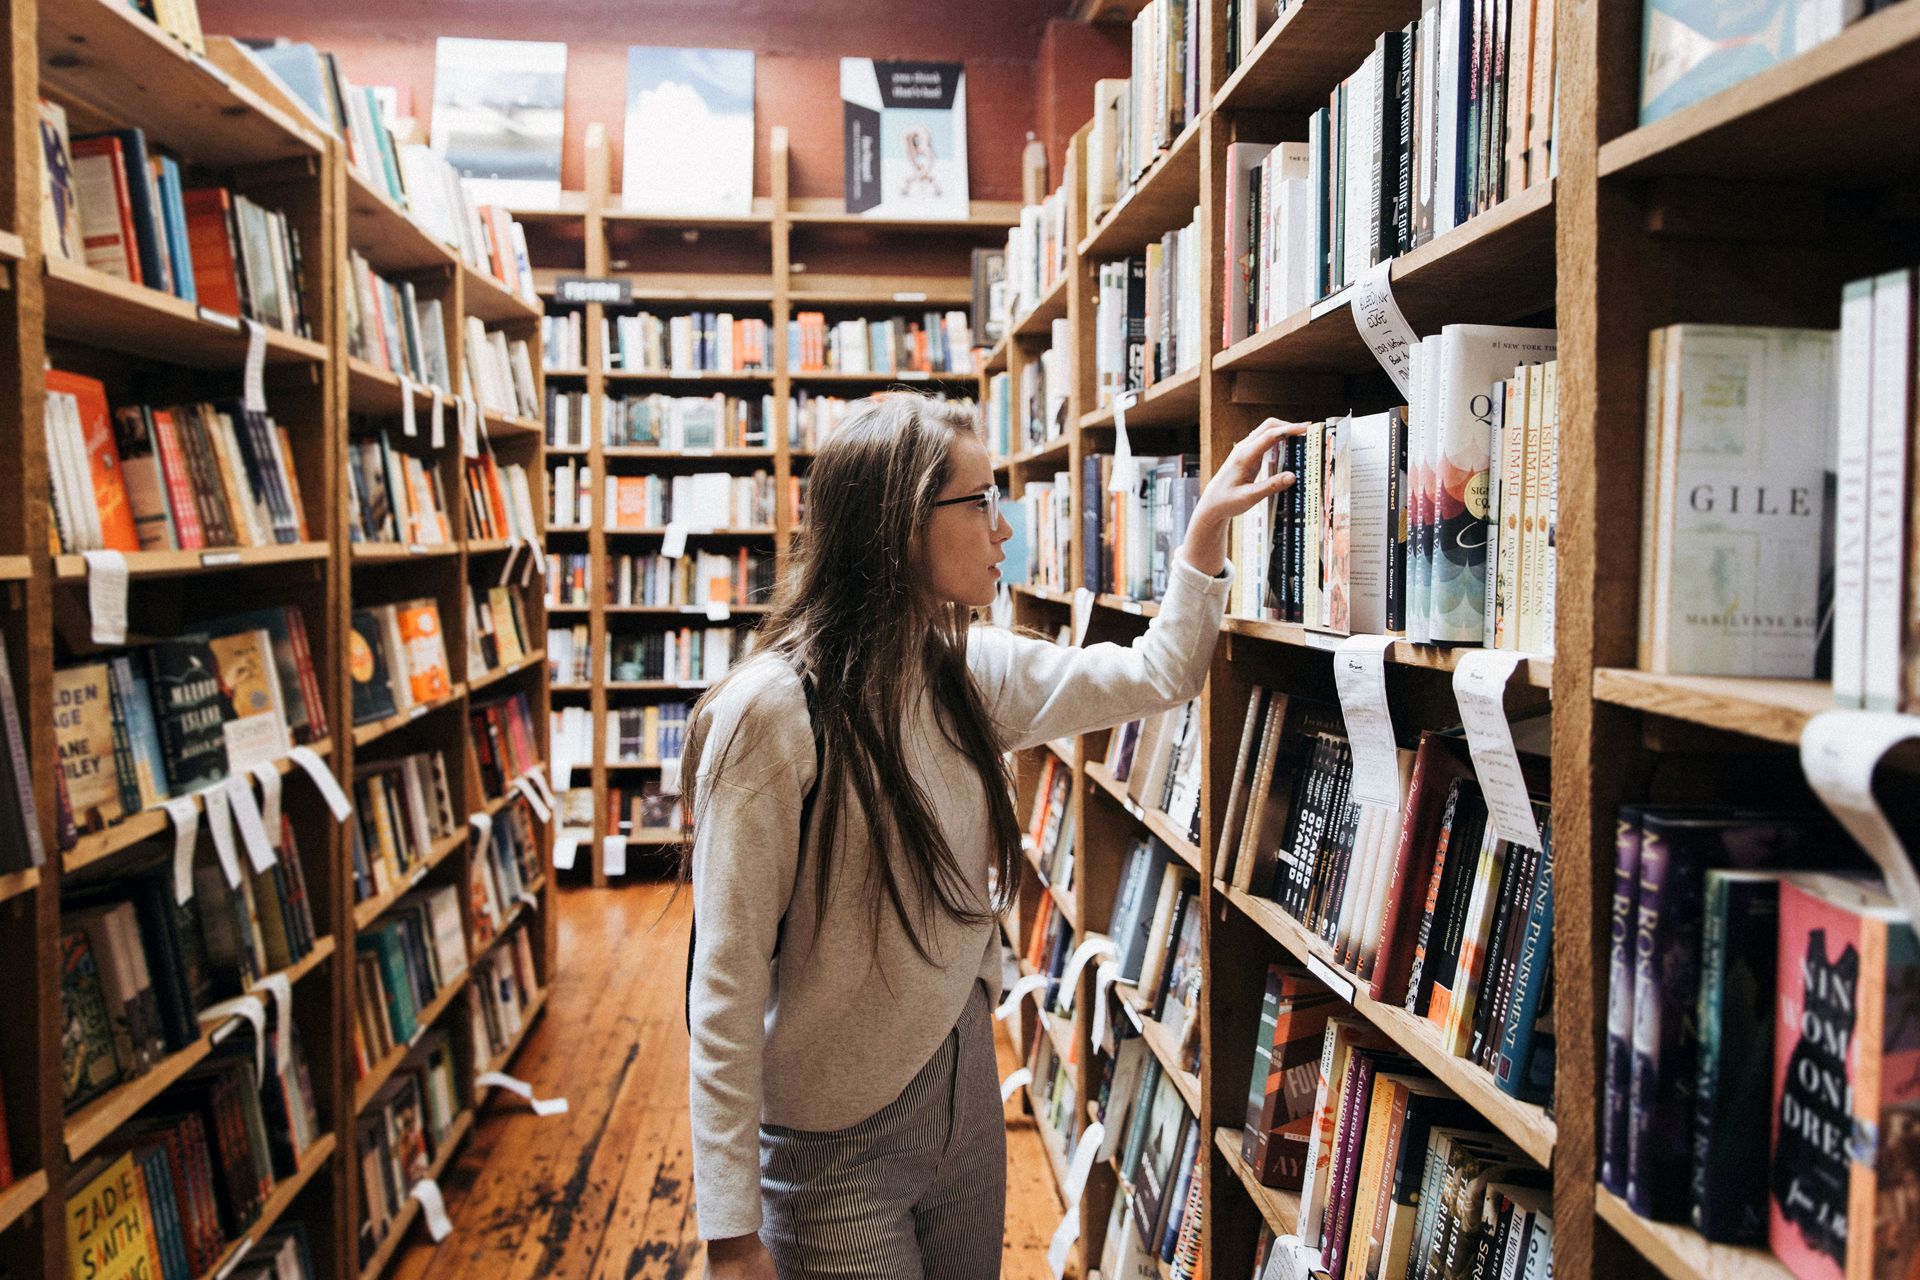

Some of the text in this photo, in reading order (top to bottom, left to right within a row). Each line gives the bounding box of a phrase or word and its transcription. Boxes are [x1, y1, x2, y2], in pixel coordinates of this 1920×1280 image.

[1397, 34, 1412, 244] THOMAS PYNCHON BLEEDING EDGE
[1370, 161, 1381, 218] BLEEDING
[1369, 220, 1379, 250] EDGE
[1417, 488, 1425, 540] MILLER'S
[1434, 476, 1442, 534] MILLER'S
[1505, 426, 1522, 611] ISHMAEL DANIEL QUINN
[1522, 428, 1538, 616] ISHMAEL DANIEL QUINN
[1535, 424, 1552, 616] ISHMAEL DANIEL QUINN
[1293, 527, 1301, 574] MATTHEW
[1686, 613, 1784, 626] MARILYNNE
[1327, 779, 1342, 839] IMPERFECTIONISTS
[1332, 781, 1348, 843] IMPERFECTIONISTS
[1288, 808, 1309, 881] OTARED
[1295, 812, 1316, 885] OTARED
[1302, 816, 1323, 890] OTARED
[1390, 827, 1408, 889] Jerusalem
[1520, 853, 1528, 873] WHY
[1326, 869, 1338, 909] Rachman
[1503, 863, 1515, 897] RAKHA
[1528, 857, 1537, 878] WHY
[1334, 872, 1347, 914] Rachman
[1382, 899, 1393, 931] NAOMI
[1452, 888, 1461, 905] Story
[1459, 892, 1468, 908] Story
[1514, 884, 1523, 906] CAME
[1522, 887, 1531, 910] CAME
[1375, 935, 1386, 967] RAGEN
[1443, 918, 1455, 951] Childhood
[1450, 922, 1462, 956] Childhood
[1484, 935, 1501, 1000] CROCODILES
[1505, 921, 1541, 1049] PUNISHMENT
[1373, 1082, 1383, 1108] KNOW
[1383, 1092, 1393, 1118] KNOW
[1368, 1112, 1378, 1137] YOUR
[1379, 1122, 1388, 1149] YOUR
[1331, 1145, 1342, 1188] WOMAN
[1335, 1080, 1364, 1242] UNRESTORED WOMAN SHOBHA
[1386, 1138, 1395, 1159] RON
[1382, 1160, 1392, 1190] RASH
[1423, 1153, 1443, 1236] Ron Rash
[74, 1170, 133, 1242] ZADIE
[1326, 1194, 1336, 1231] SHOBHA
[1375, 1191, 1386, 1231] READER
[1432, 1164, 1456, 1254] THE RISEN
[1445, 1176, 1469, 1268] THE RISEN
[83, 1207, 142, 1280] SMITH
[1491, 1222, 1506, 1277] RON RASH
[1502, 1213, 1523, 1279] THE WORLD
